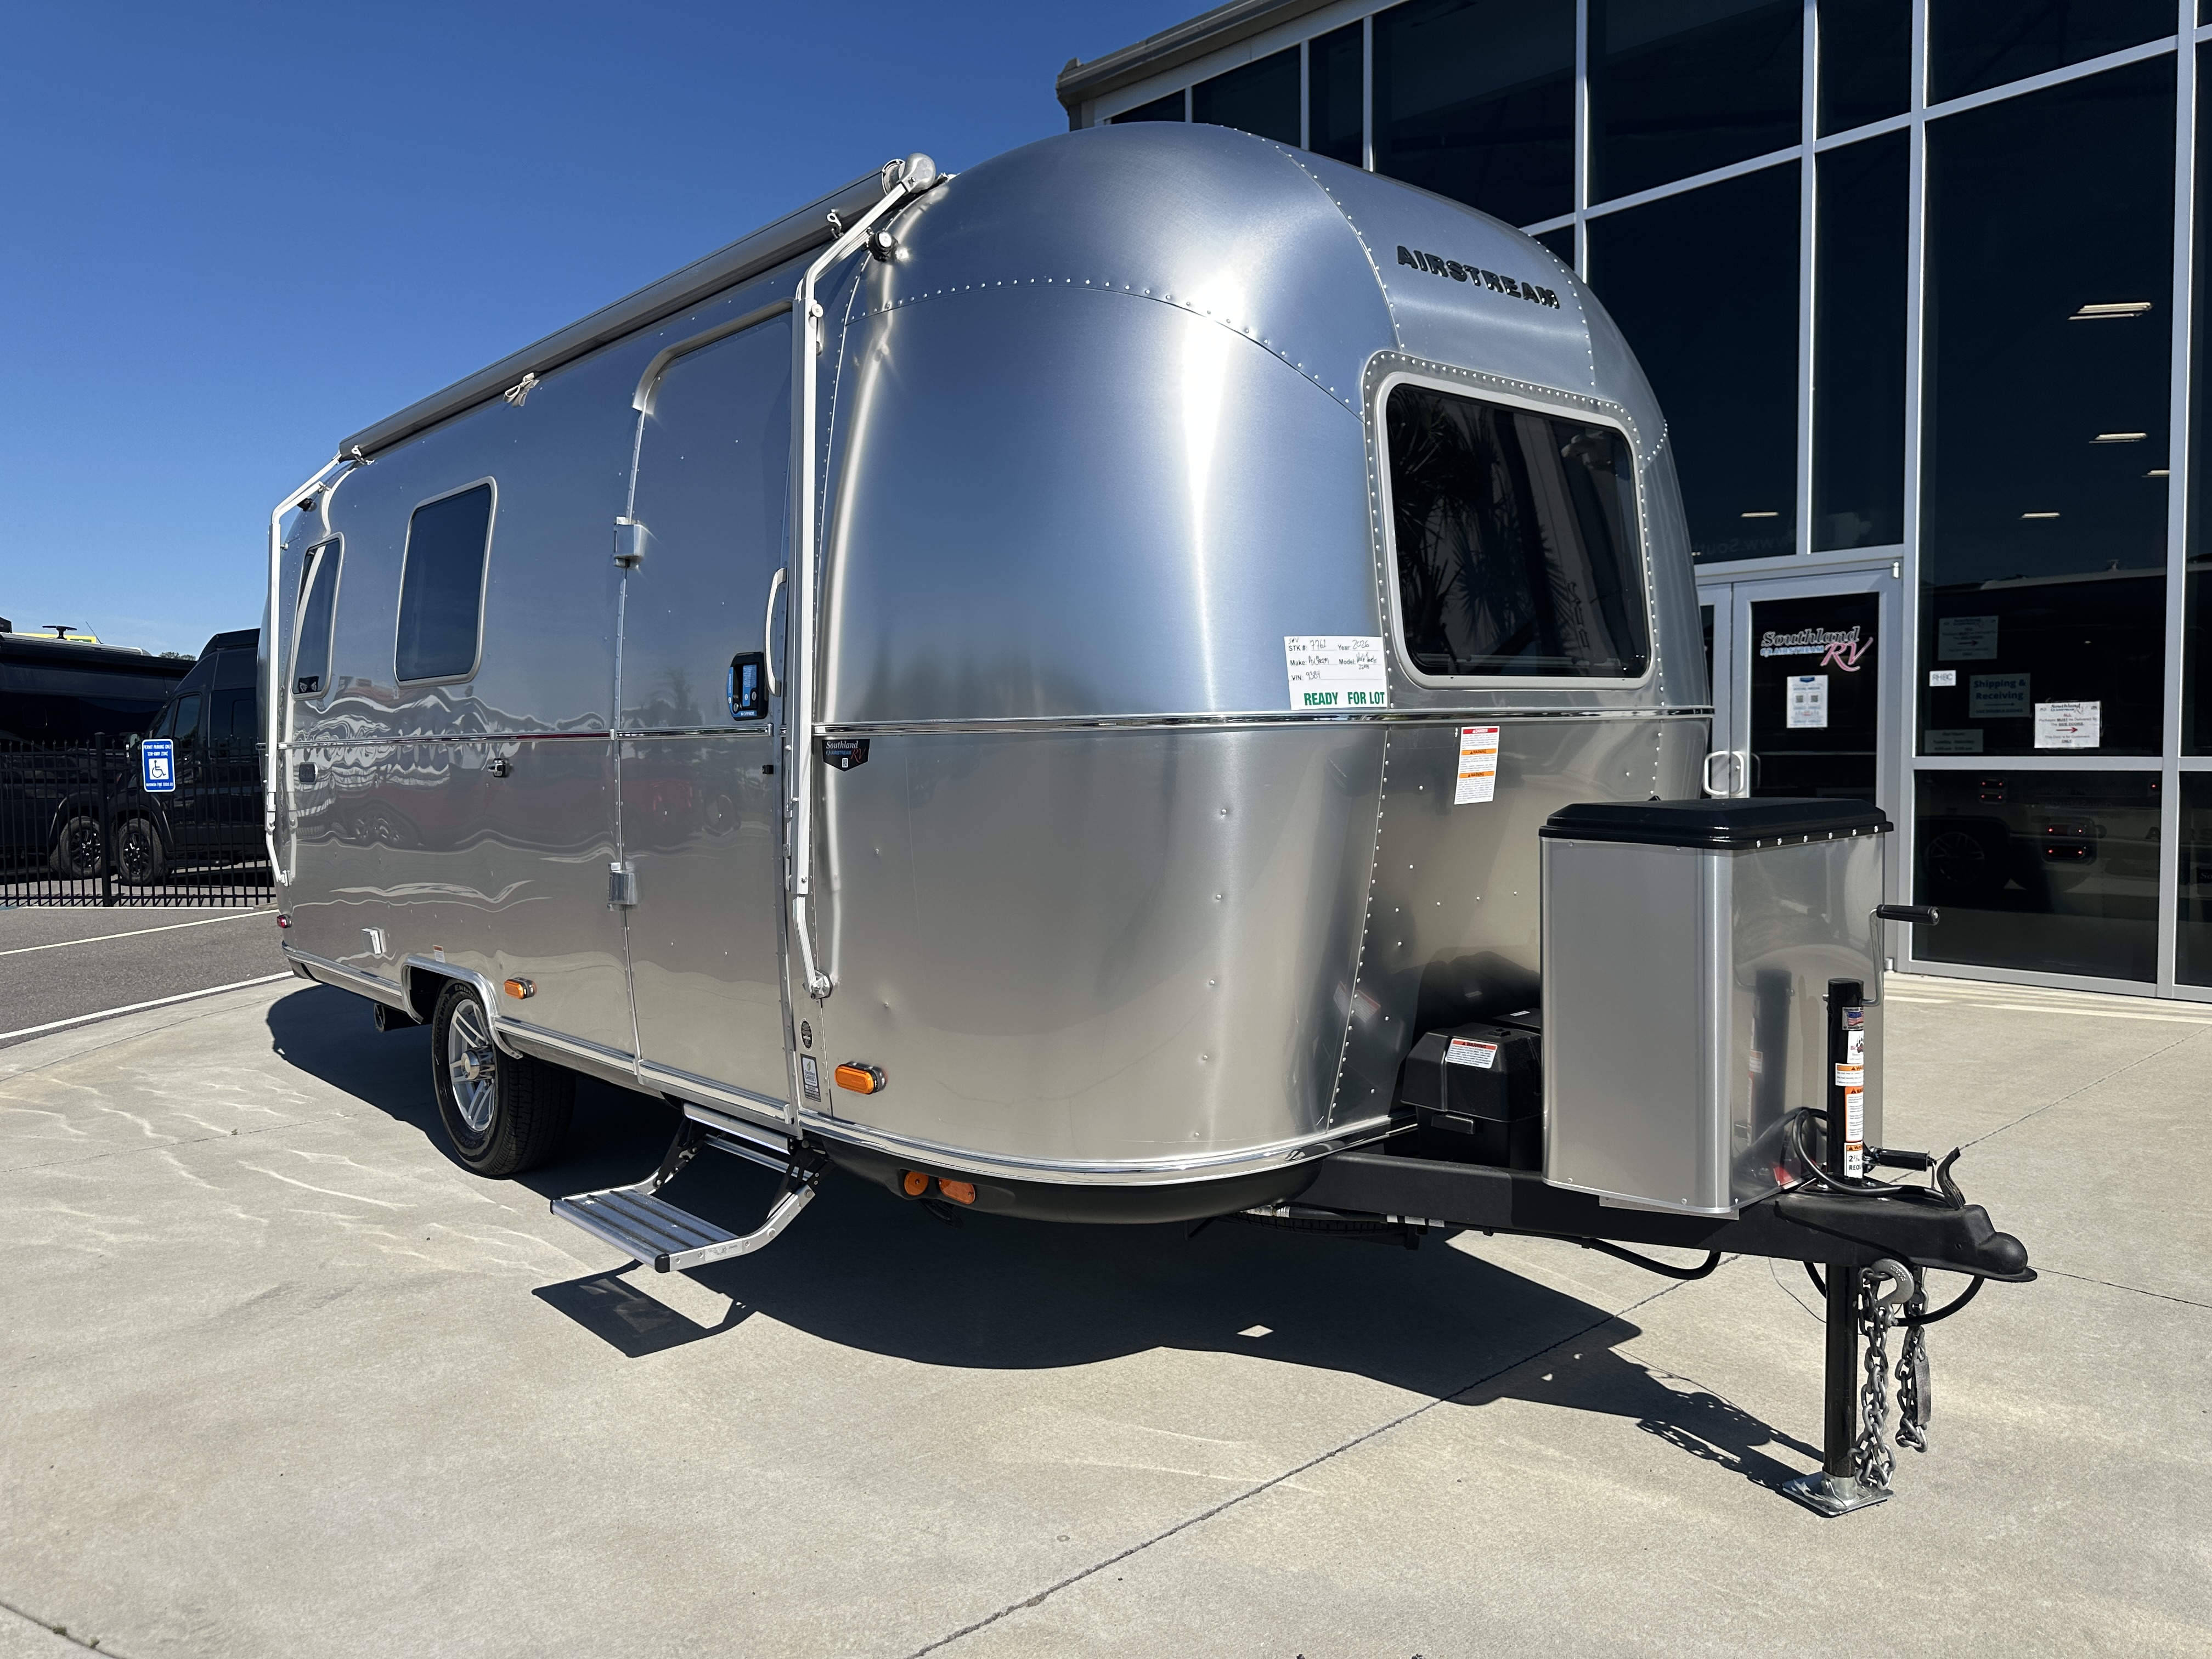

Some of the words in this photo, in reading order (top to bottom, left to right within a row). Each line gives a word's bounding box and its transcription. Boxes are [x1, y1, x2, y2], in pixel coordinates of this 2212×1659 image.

[1397, 245, 1560, 309] AIRSTREAM
[1760, 625, 1860, 647] Southland
[1352, 640, 1369, 650] 2026
[1820, 636, 1874, 672] RV
[1974, 679, 2016, 689] Shipping
[1304, 692, 1338, 706] READY
[1347, 691, 1367, 705] FOR
[1369, 691, 1385, 704] LOT
[1976, 691, 2024, 701] Receiving
[826, 741, 859, 749] Southland
[850, 747, 866, 763] RV
